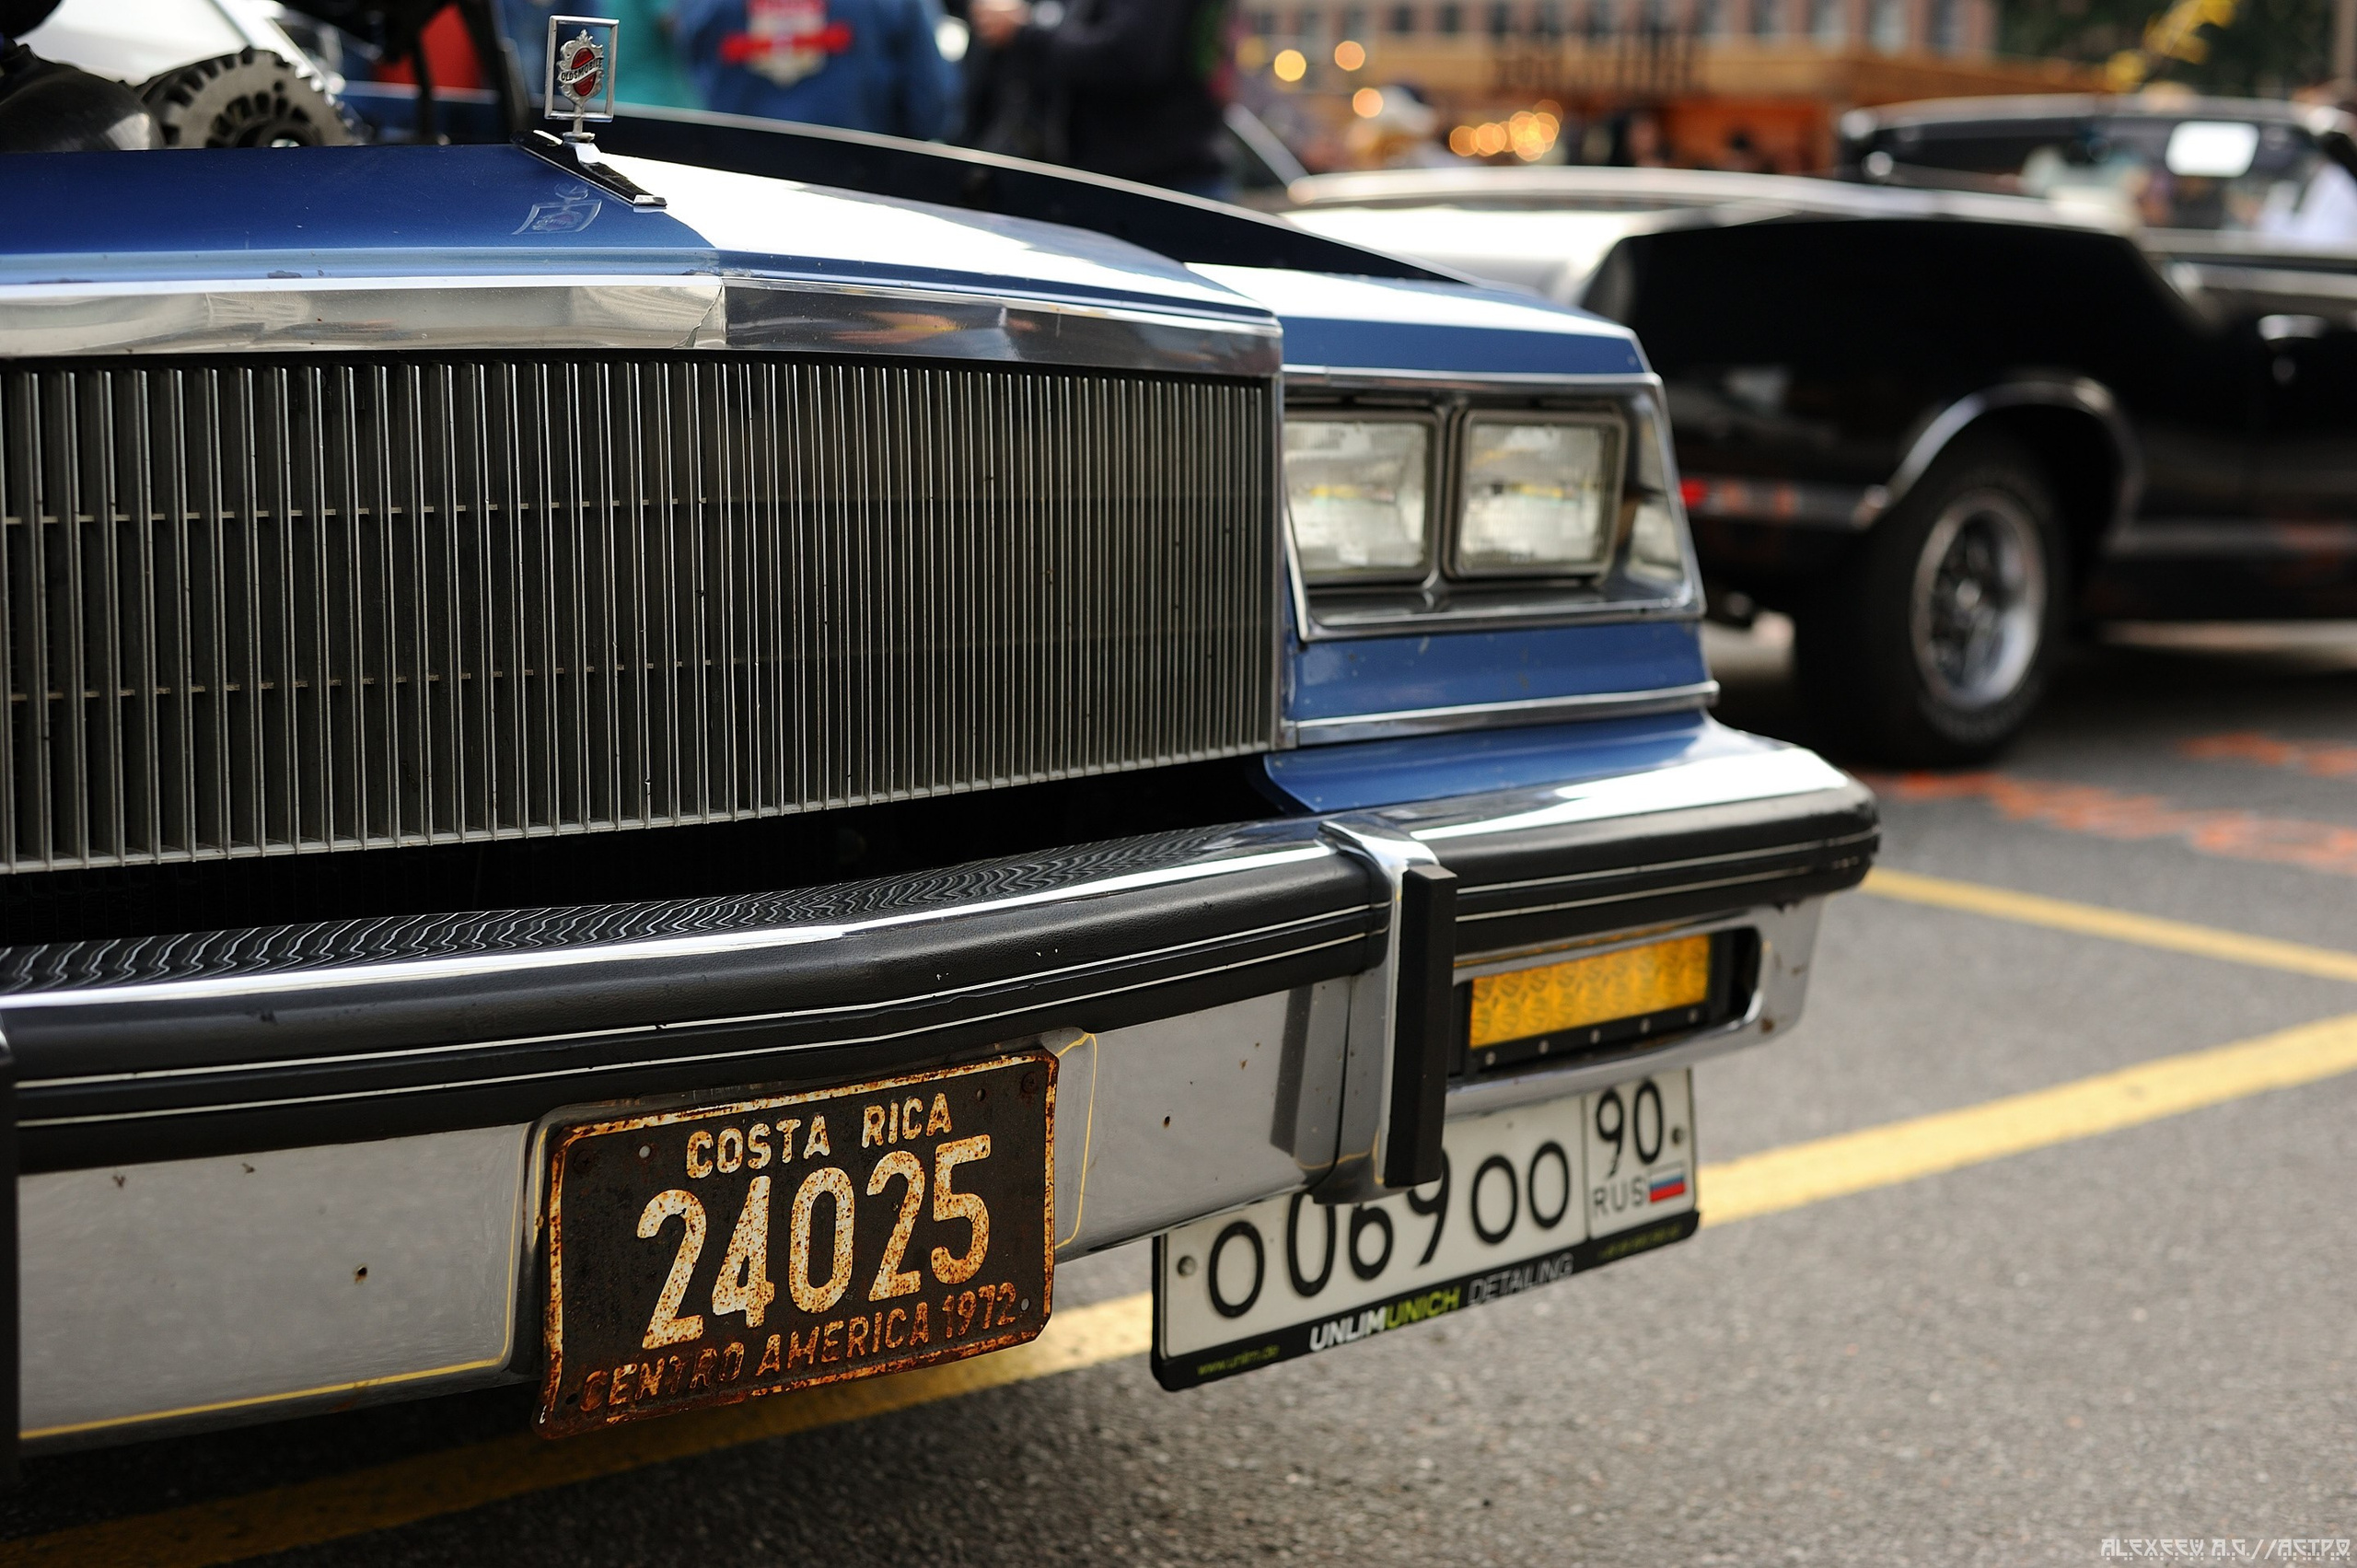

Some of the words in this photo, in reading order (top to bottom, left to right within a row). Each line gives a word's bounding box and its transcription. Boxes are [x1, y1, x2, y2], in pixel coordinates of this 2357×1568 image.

[561, 57, 604, 82] OLDSMOBILE
[686, 1115, 830, 1179] COSTA
[862, 1092, 952, 1149] RICA
[1596, 1078, 1664, 1178] 90
[636, 1133, 991, 1350] 24025
[1593, 1176, 1646, 1216] RUS
[579, 1342, 746, 1412] CENTRO
[755, 1301, 929, 1376] AMERICA
[941, 1282, 1017, 1339] 1972
